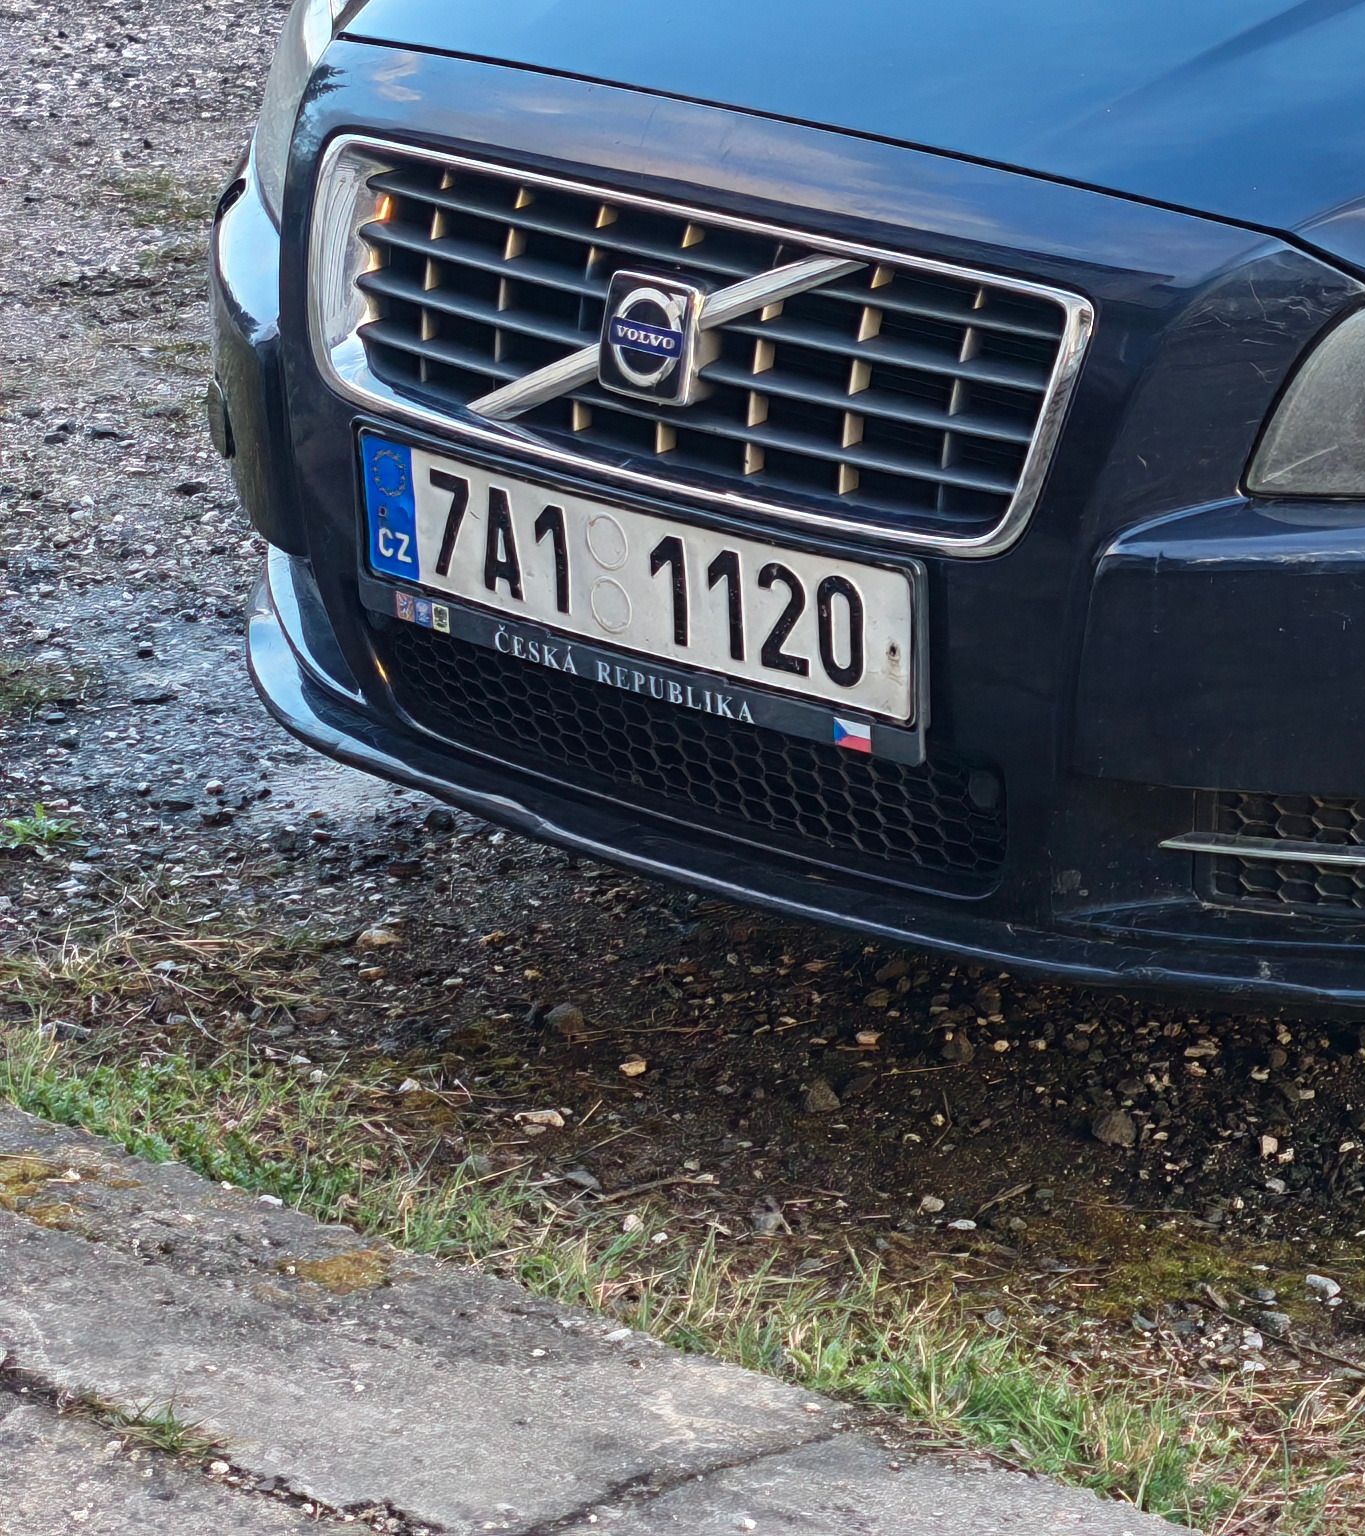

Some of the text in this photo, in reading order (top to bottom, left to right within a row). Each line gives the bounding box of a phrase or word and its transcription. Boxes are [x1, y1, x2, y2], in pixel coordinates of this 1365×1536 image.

[616, 324, 676, 351] VOLVO
[378, 526, 413, 564] CZ
[429, 467, 865, 689] 7A1 1120
[494, 623, 756, 725] ČESKÁ REPUBLIKA
